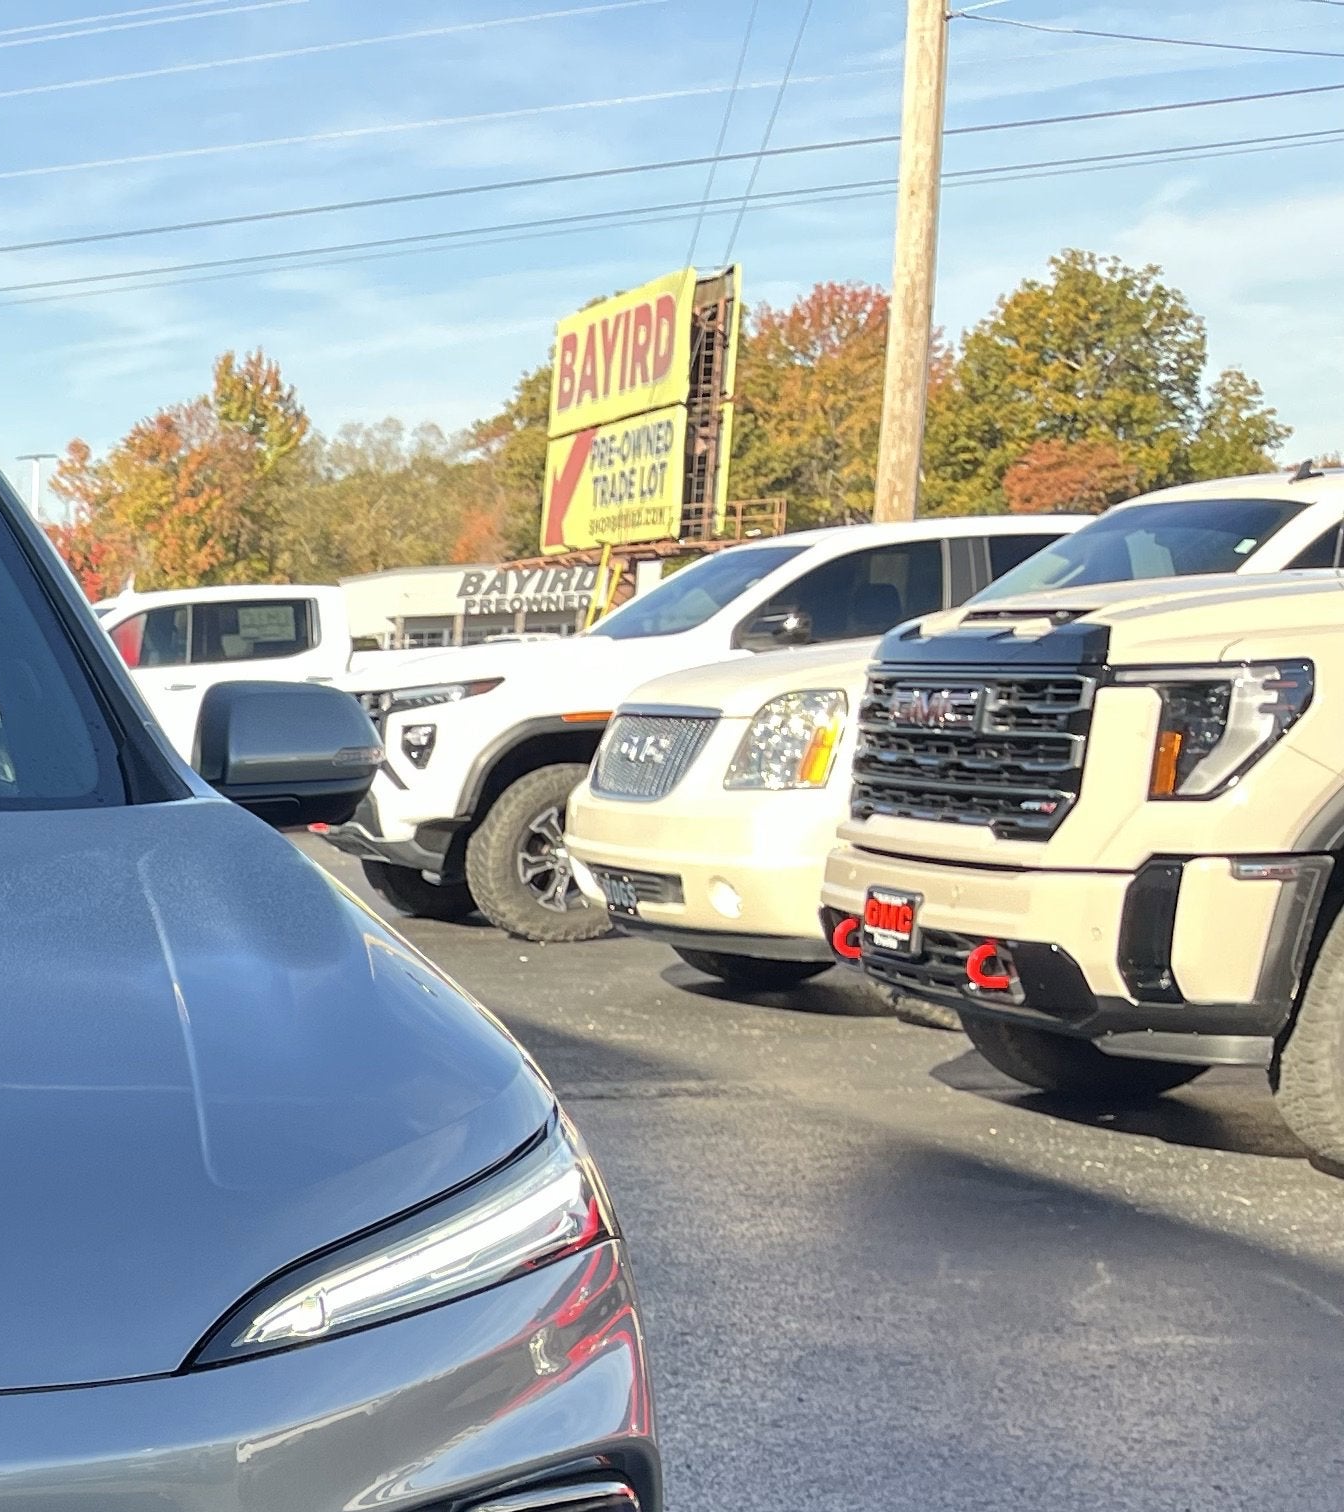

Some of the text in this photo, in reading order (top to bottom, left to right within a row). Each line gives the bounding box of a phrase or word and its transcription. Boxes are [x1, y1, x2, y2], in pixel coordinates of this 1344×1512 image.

[557, 295, 676, 413] BAYIRD
[590, 419, 674, 472] PRE-OWNED
[593, 461, 667, 511] TRADE LOT
[458, 565, 599, 597] BAYIRD
[464, 594, 593, 615] PREOWNED
[866, 898, 913, 933] GMC
